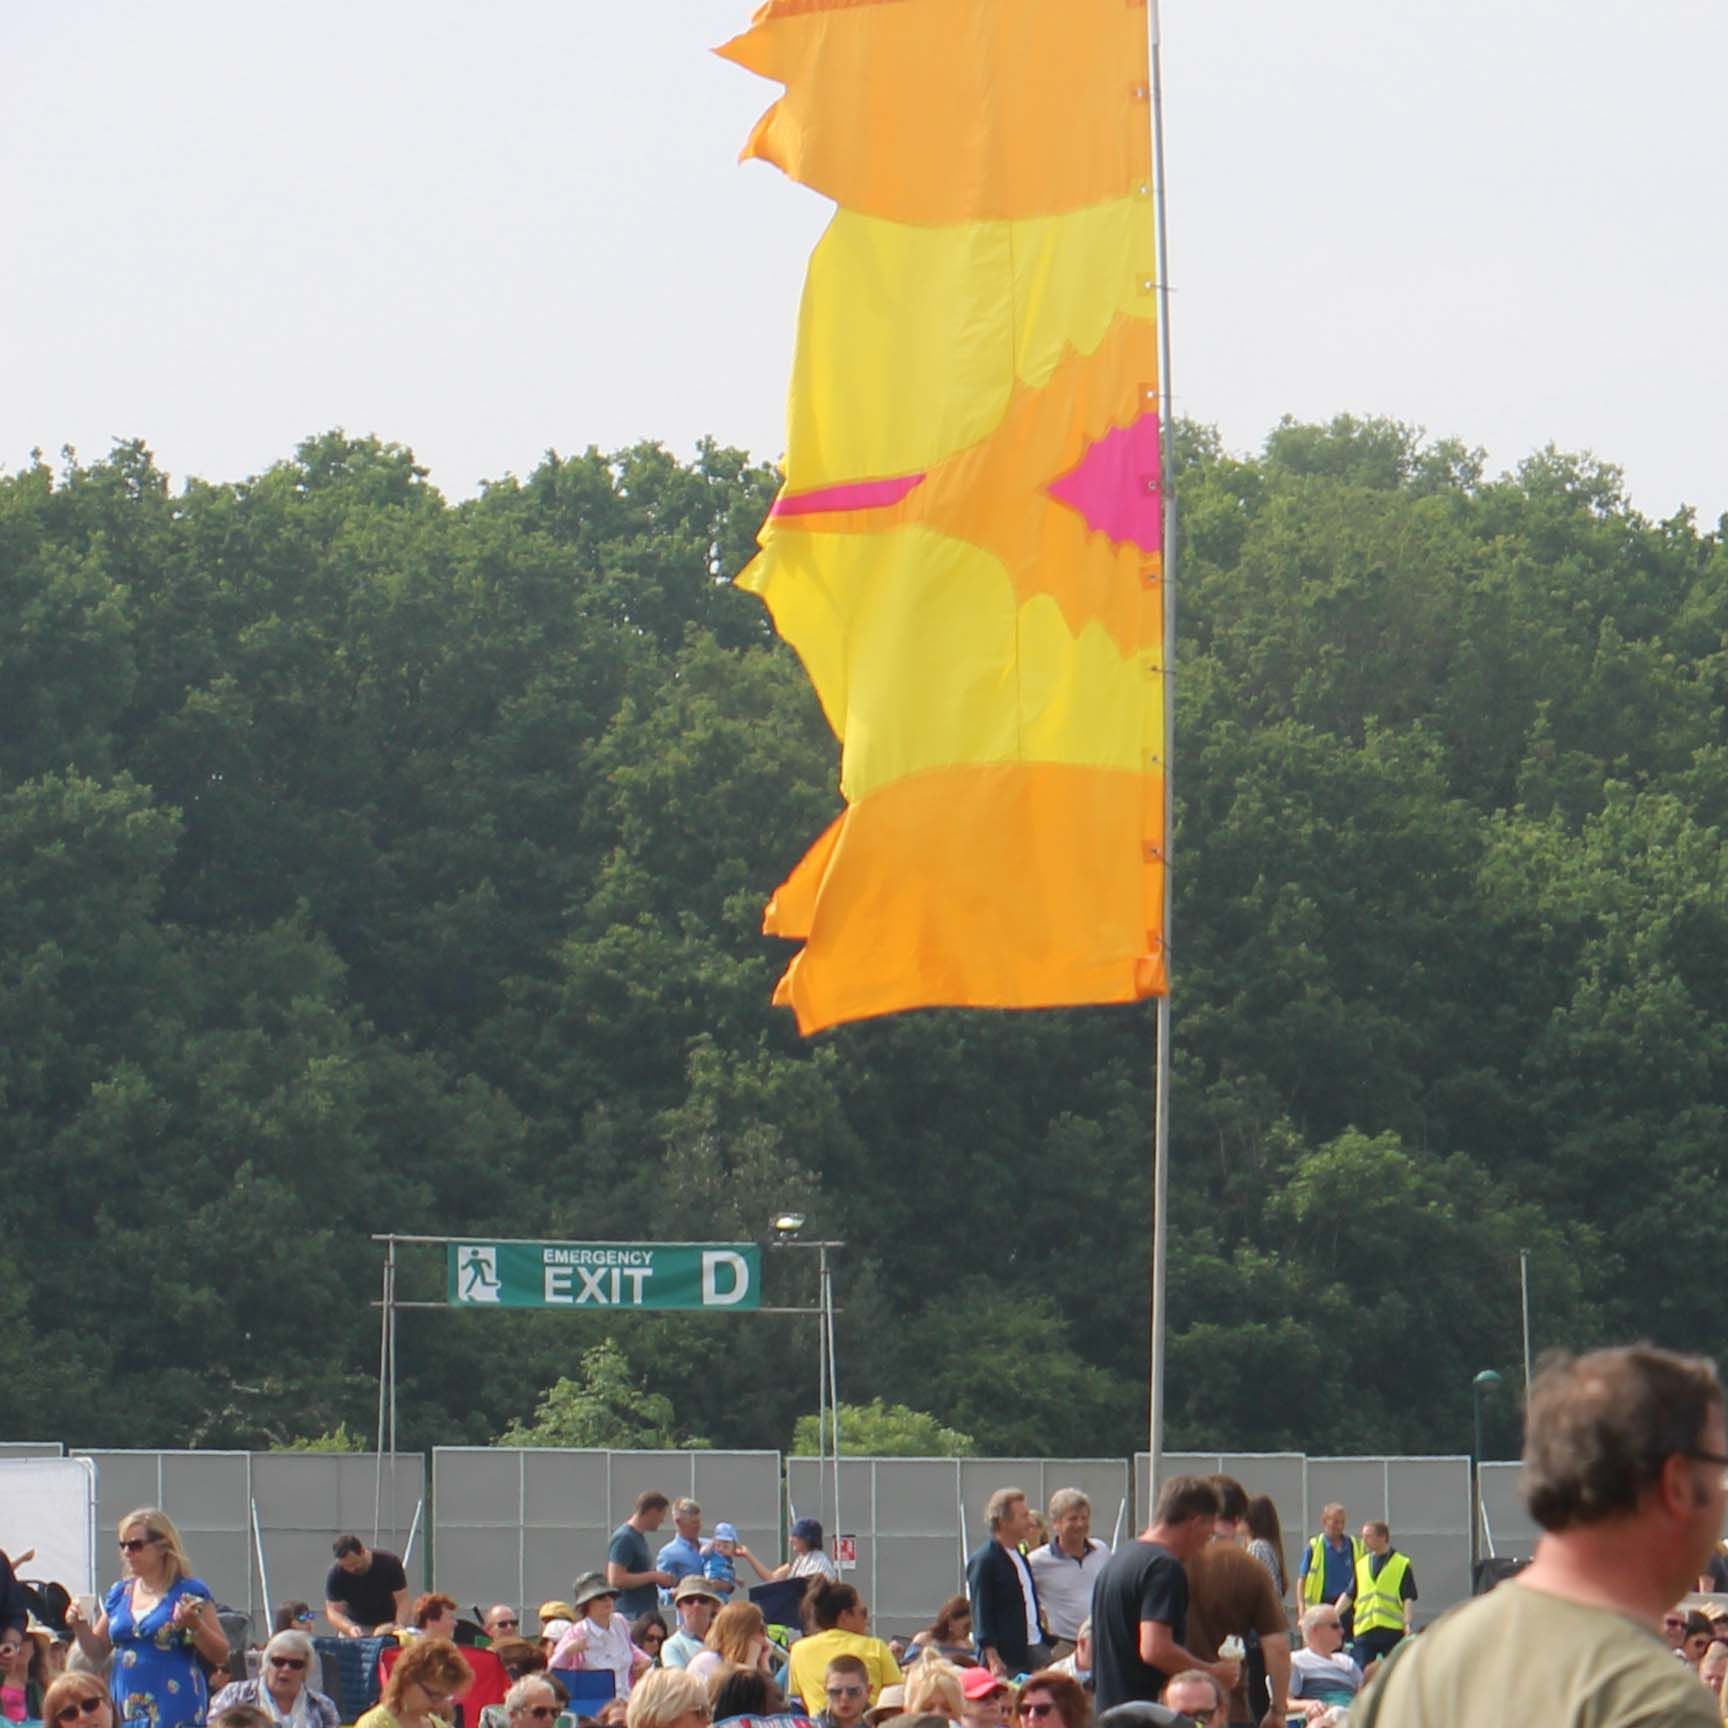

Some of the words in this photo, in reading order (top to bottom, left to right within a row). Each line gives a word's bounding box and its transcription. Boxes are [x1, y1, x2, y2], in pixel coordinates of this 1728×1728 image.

[543, 1248, 654, 1265] EMERGENCY
[544, 1266, 653, 1304] EXIT
[702, 1250, 749, 1305] D
